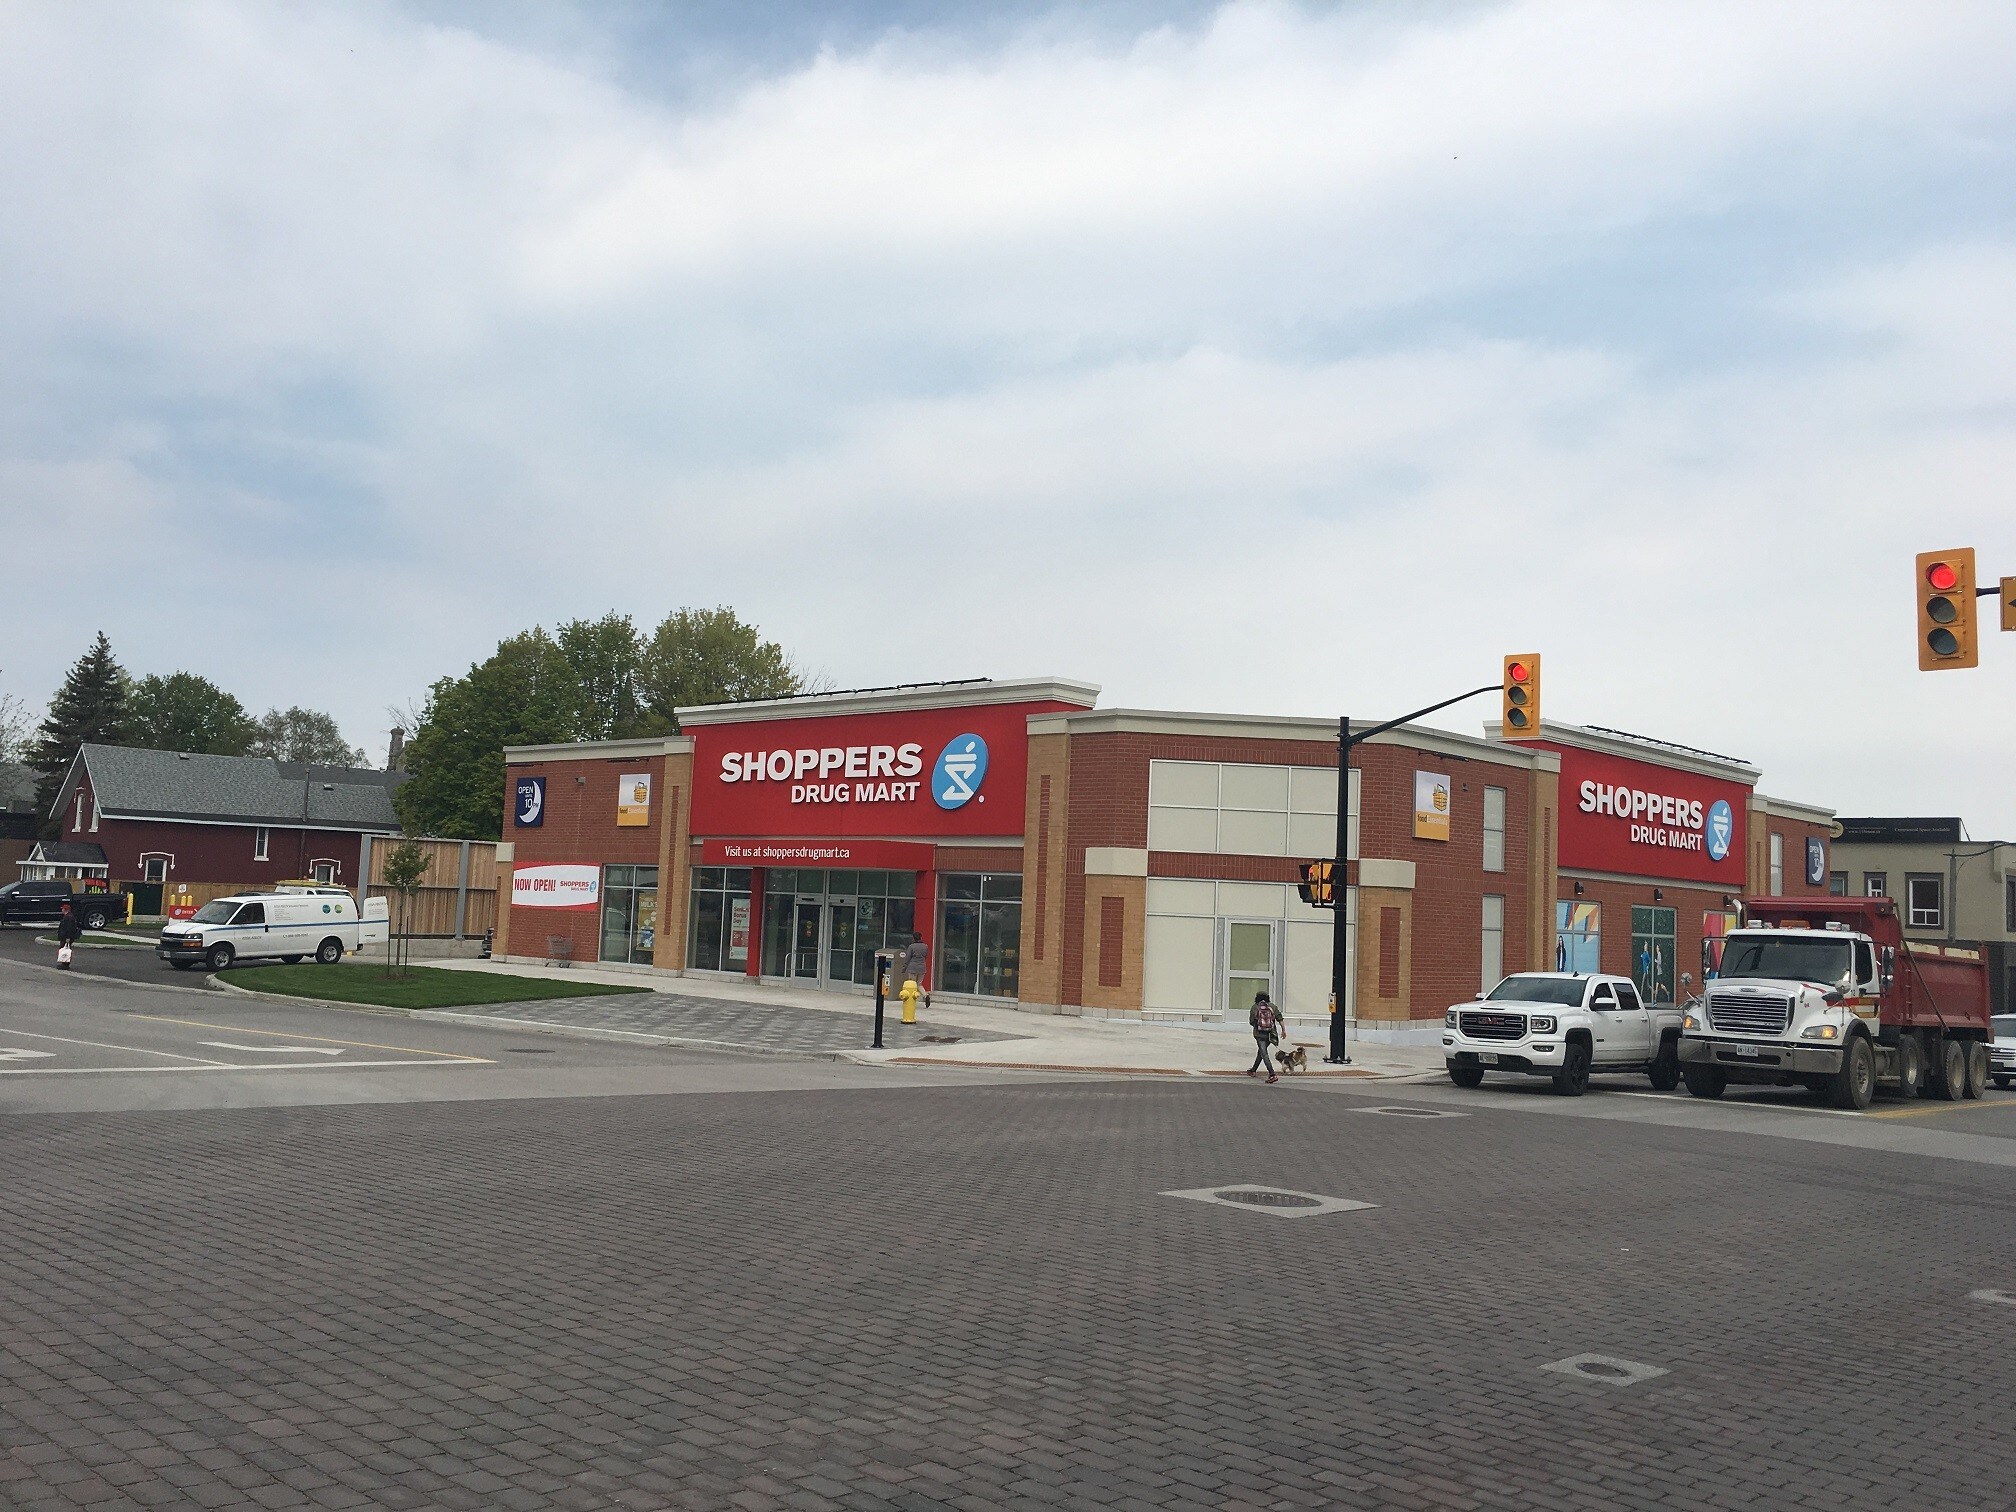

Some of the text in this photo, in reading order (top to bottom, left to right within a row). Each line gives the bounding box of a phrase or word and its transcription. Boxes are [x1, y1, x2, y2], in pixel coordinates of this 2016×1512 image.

[719, 743, 923, 783] SHOPPERS
[518, 786, 533, 794] OPEN
[791, 781, 921, 803] DRUG MART
[525, 798, 533, 808] 10
[1579, 779, 1704, 830] SHOPPERS
[1417, 814, 1428, 823] food
[1630, 824, 1703, 851] DRUG MART
[725, 845, 850, 860] Visit us at shoppersdrugmart.ca
[514, 878, 557, 892] NOW OPEN!
[560, 880, 589, 888] SHOPPERS
